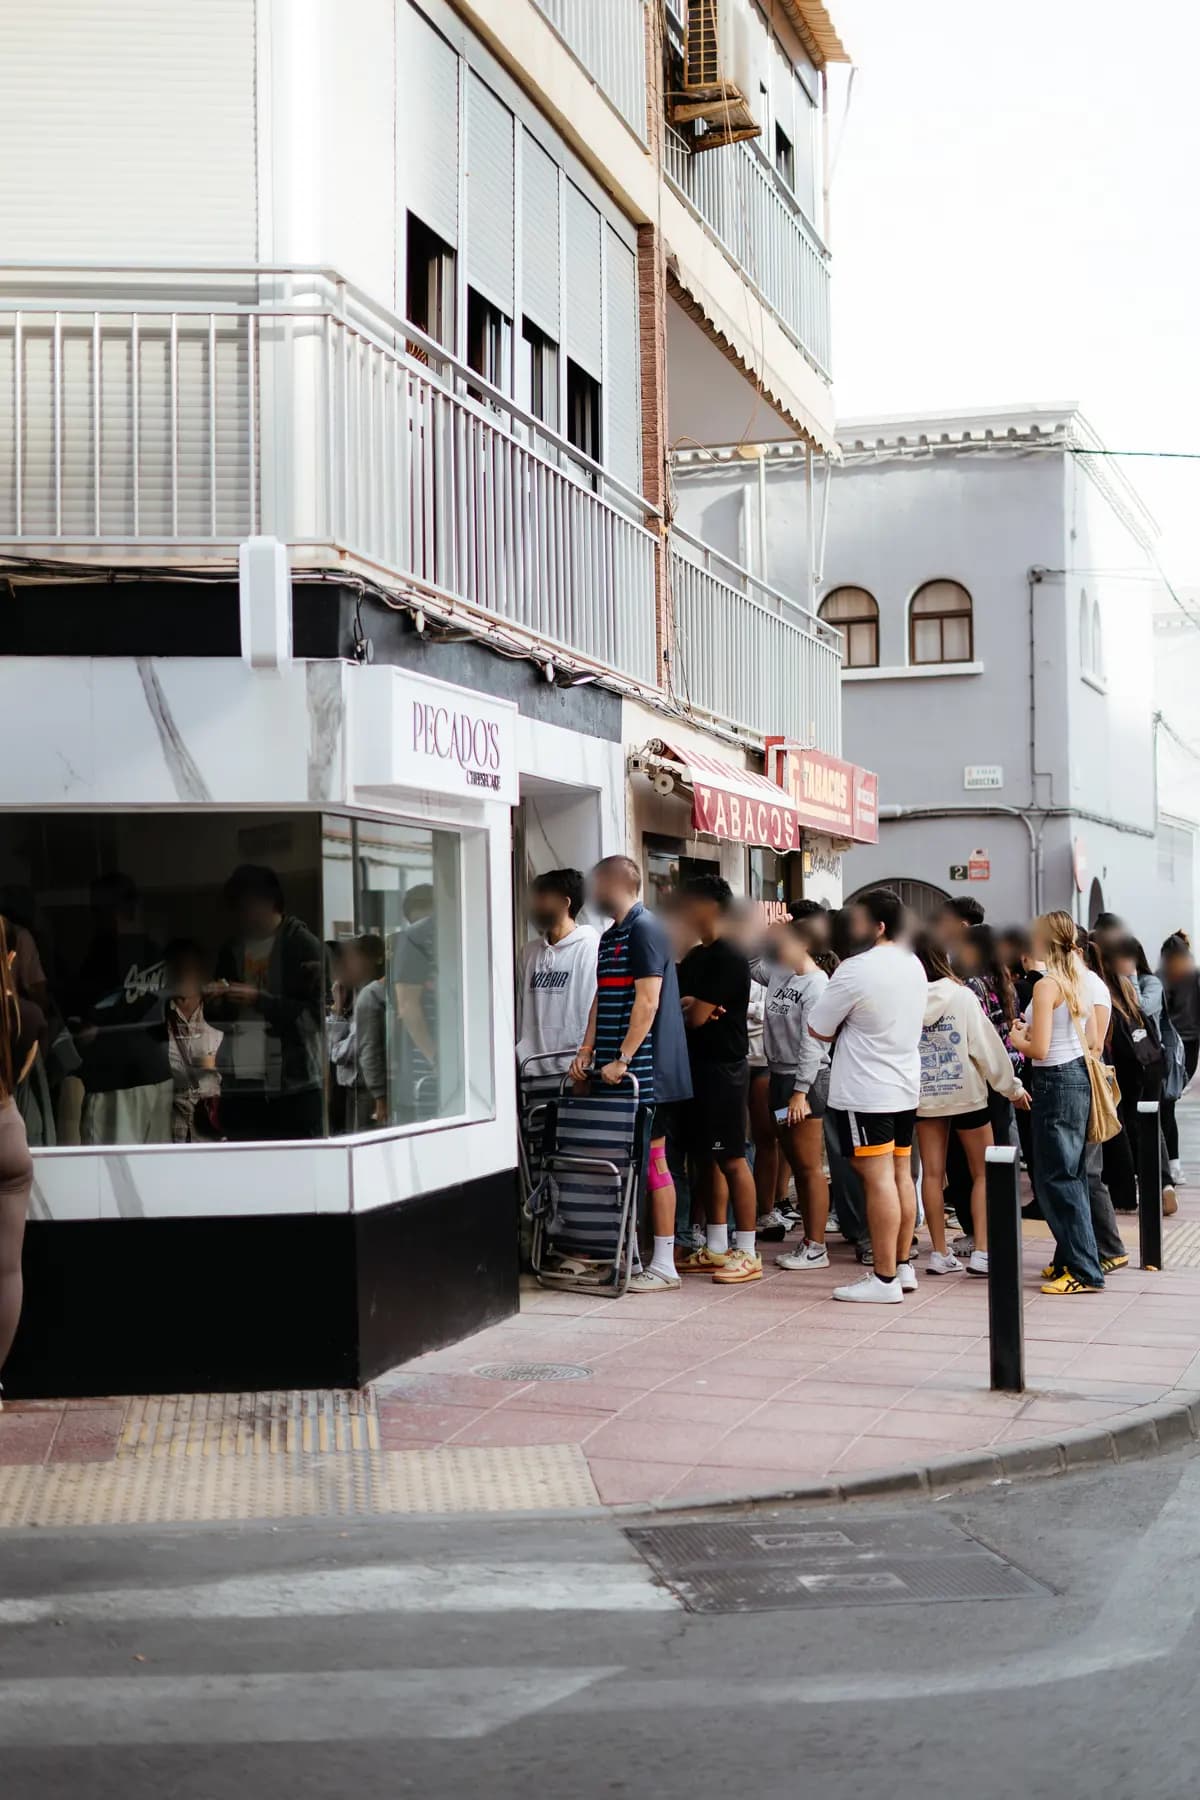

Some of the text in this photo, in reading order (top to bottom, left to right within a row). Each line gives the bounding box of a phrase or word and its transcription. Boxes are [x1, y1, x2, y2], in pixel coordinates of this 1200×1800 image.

[413, 701, 500, 770] PECADO'S
[803, 761, 847, 809] TABACOS
[700, 788, 794, 848] TABACOS
[954, 865, 964, 880] 2
